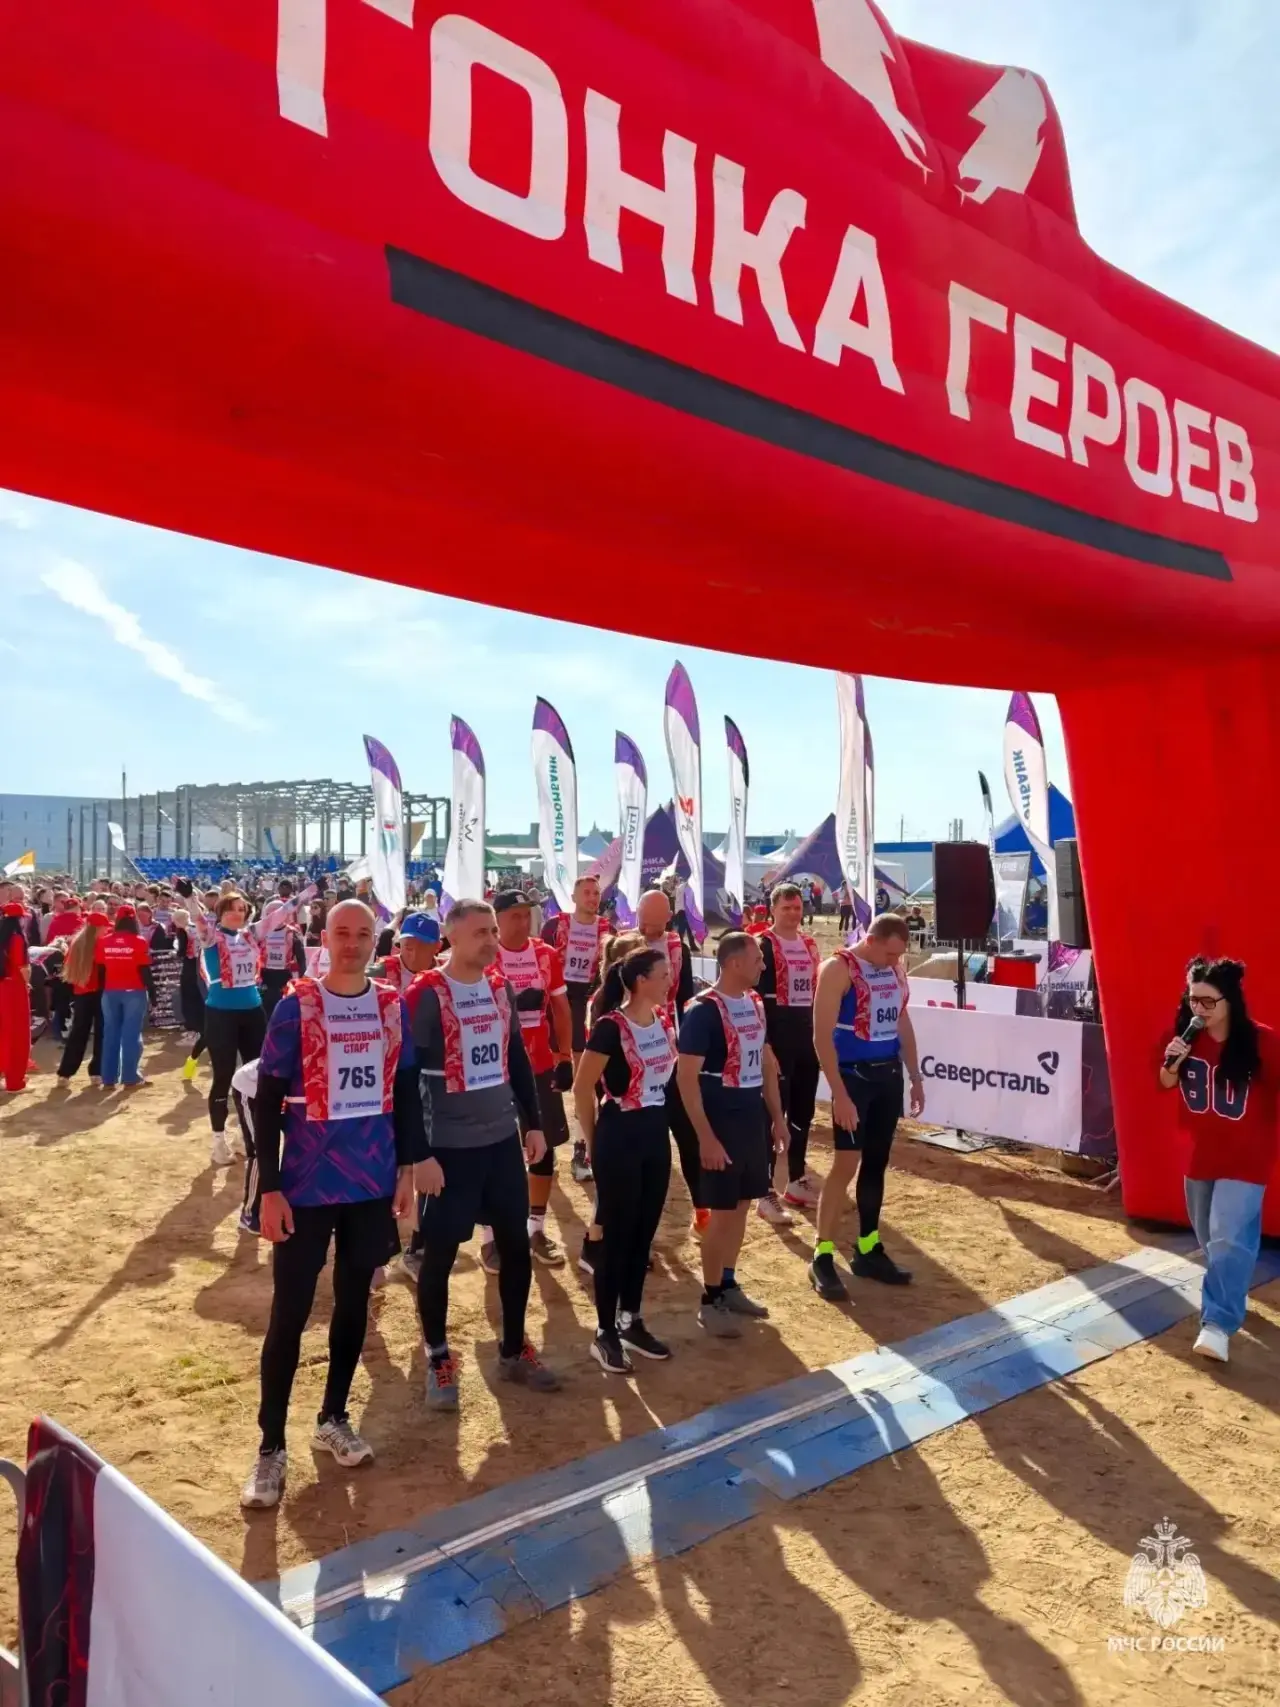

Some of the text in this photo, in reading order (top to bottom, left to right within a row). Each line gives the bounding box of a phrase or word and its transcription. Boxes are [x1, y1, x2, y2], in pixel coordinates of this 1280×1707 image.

[276, 0, 1258, 524] ГОНКА ГЕРОЕВ
[236, 962, 253, 975] 712
[570, 957, 590, 970] 612
[876, 1006, 898, 1023] 640
[330, 1028, 382, 1043] МАССОВЫЙ
[343, 1042, 370, 1054] СТАРТ
[471, 1043, 499, 1066] 620
[747, 1048, 763, 1068] 71
[338, 1065, 377, 1091] 765
[920, 1055, 1050, 1096] Северсталь
